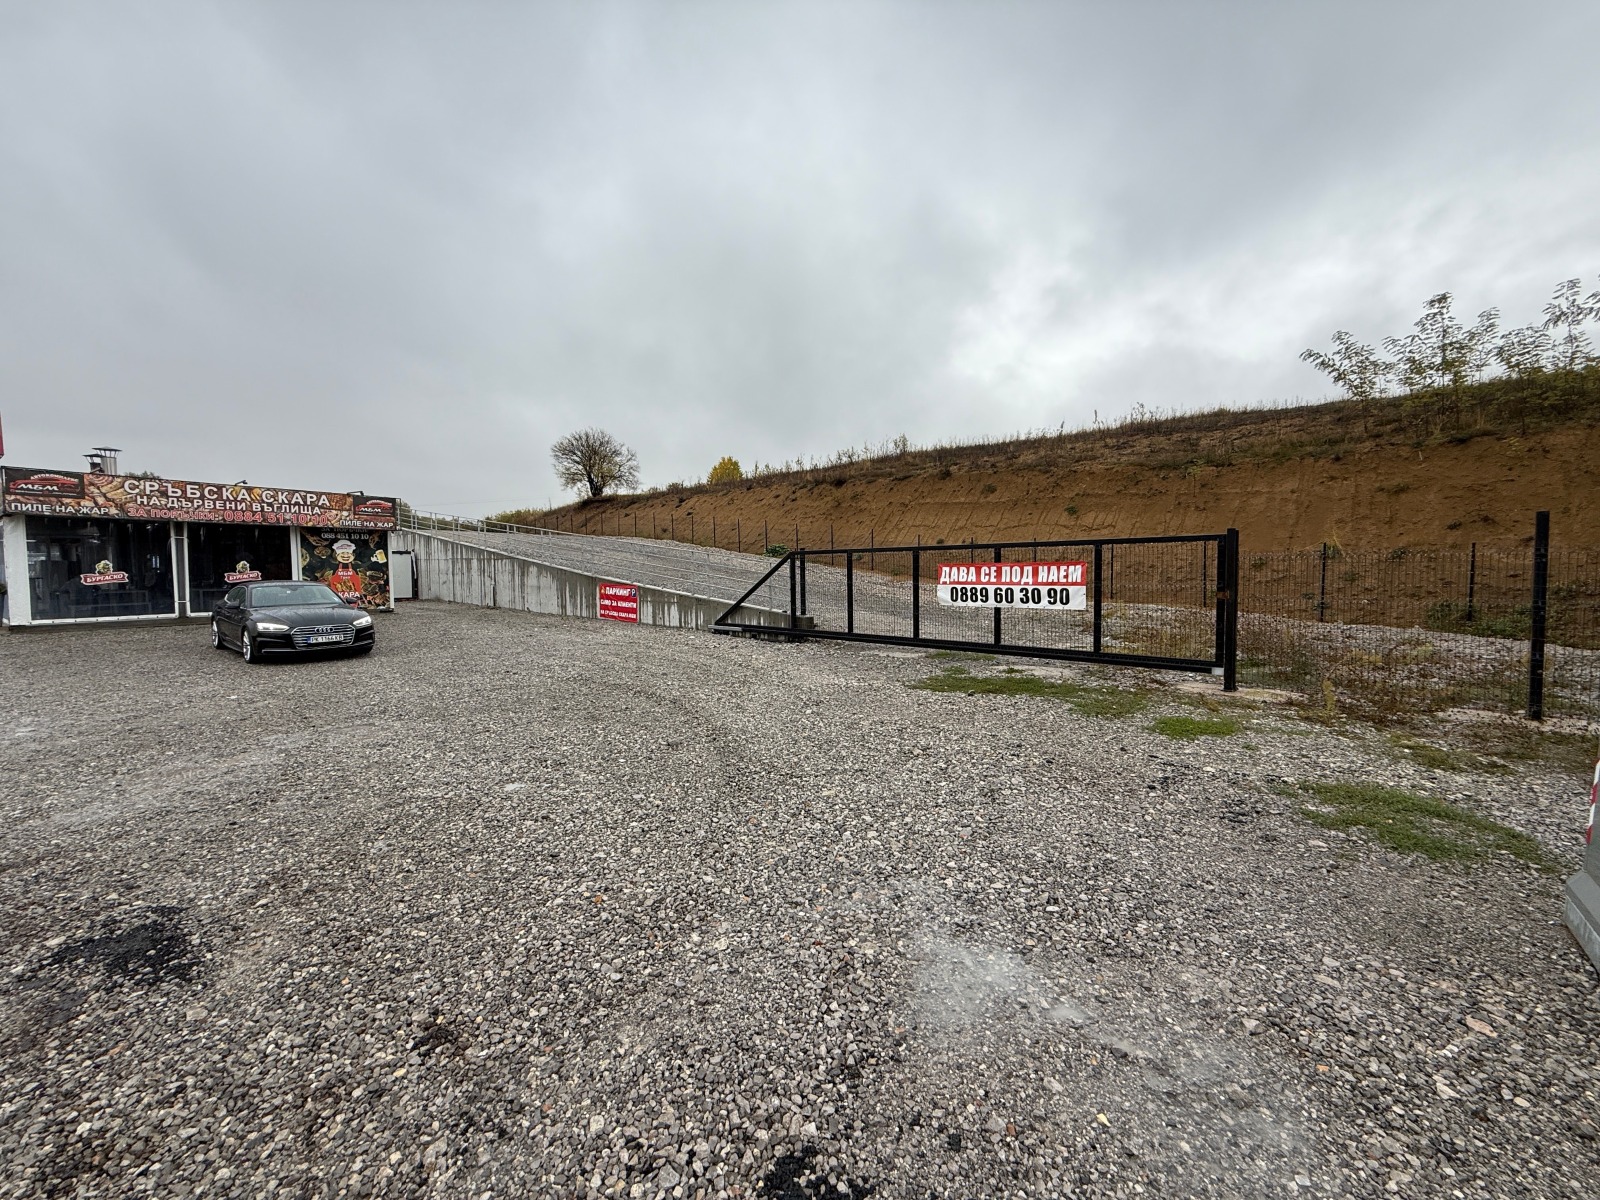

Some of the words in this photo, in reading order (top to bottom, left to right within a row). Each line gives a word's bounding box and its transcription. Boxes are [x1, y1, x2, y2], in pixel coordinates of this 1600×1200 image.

[17, 483, 59, 491] МБМ
[124, 480, 250, 501] СРЪБСКА
[262, 490, 330, 507] СКАРА
[11, 502, 52, 513] ПИЛЕ
[56, 505, 75, 514] НА
[79, 506, 109, 515] ЖАР
[136, 495, 160, 506] НА
[167, 497, 246, 511] ДЪРВЕНИ
[252, 503, 321, 515] ВЪГЛИЩА
[127, 508, 147, 518] ЗА
[224, 510, 262, 522] 0884
[267, 513, 284, 524] 51
[291, 514, 307, 525] 10
[312, 515, 328, 526] 10
[86, 573, 124, 583] БУРГАСКО
[939, 566, 976, 584] ДАВА
[980, 566, 997, 583] СЕ
[1001, 566, 1033, 585] ПОД
[1038, 565, 1082, 583] НАЕМ
[606, 587, 630, 596] ПАРКИНГ
[950, 587, 989, 603] 0889
[993, 587, 1015, 604] 60
[1019, 587, 1042, 604] 30
[1047, 588, 1070, 605] 90
